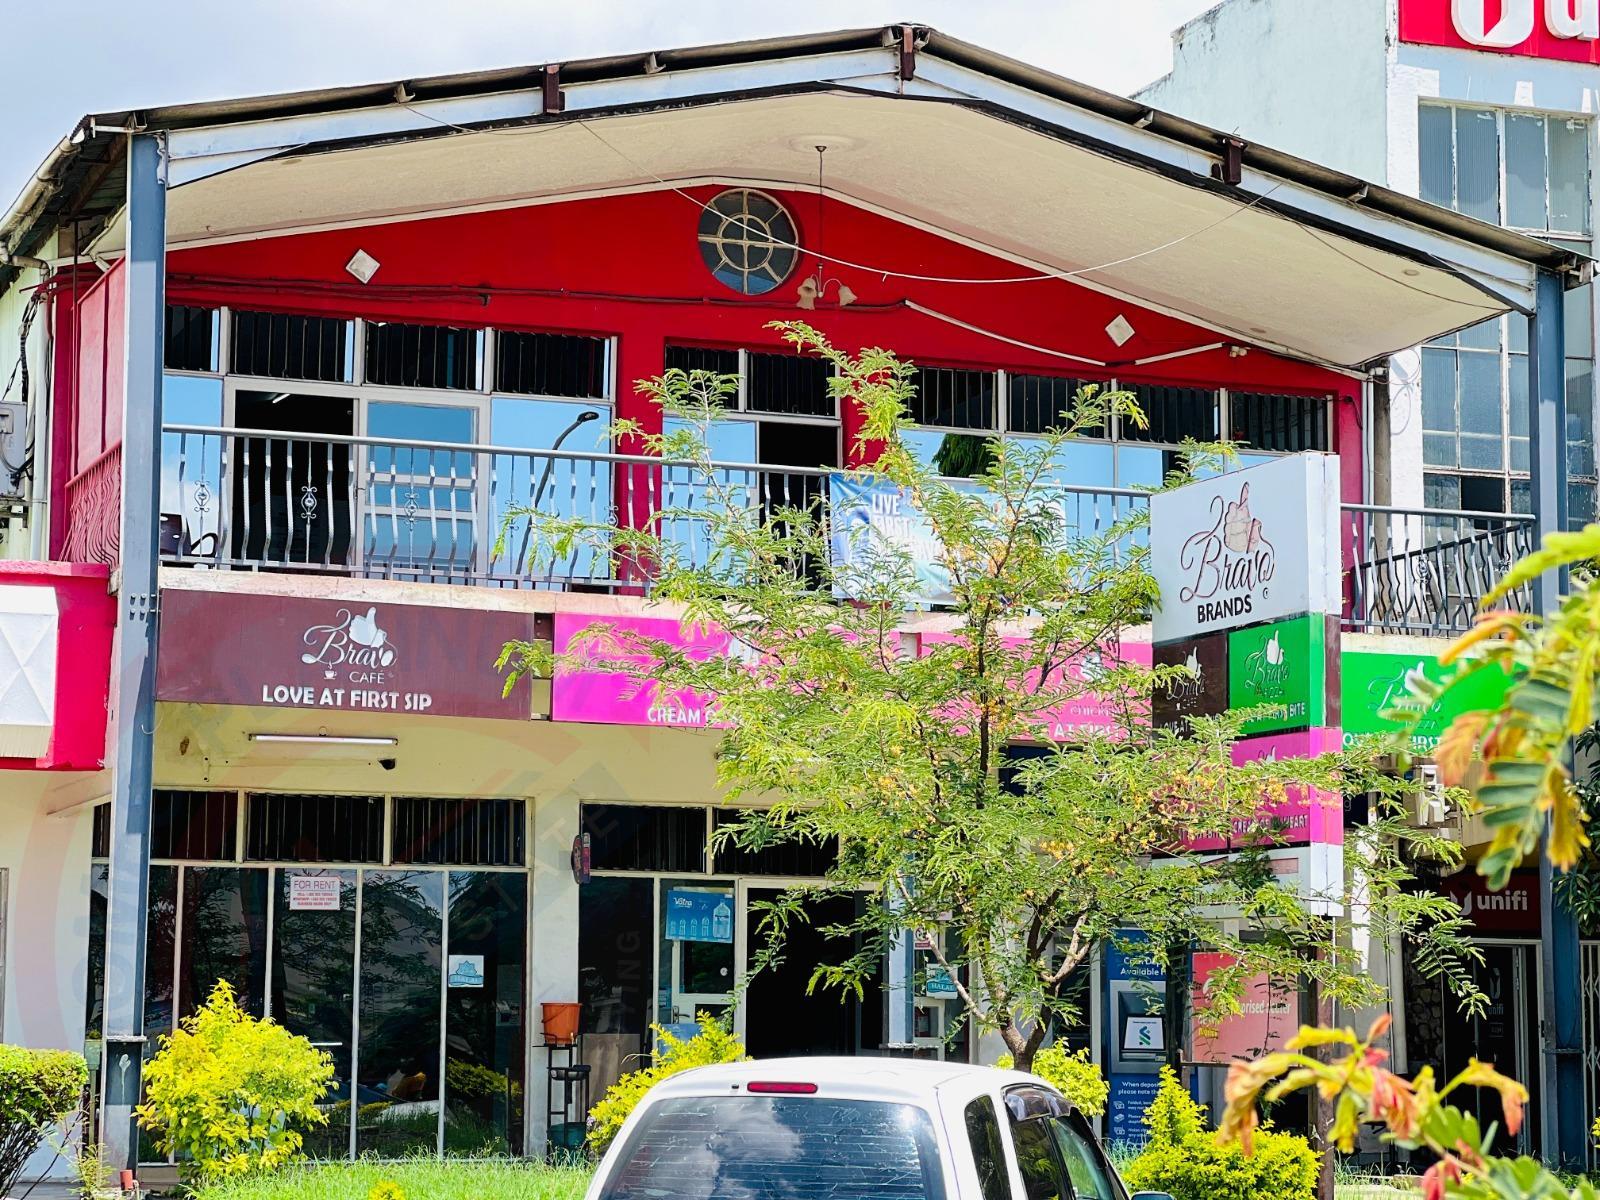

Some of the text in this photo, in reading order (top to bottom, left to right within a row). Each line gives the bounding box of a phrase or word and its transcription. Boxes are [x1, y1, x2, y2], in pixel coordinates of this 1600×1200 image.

[872, 493, 901, 515] LIVE
[1180, 496, 1275, 603] Bravo
[1197, 594, 1253, 624] BRANDS
[301, 609, 399, 670] Bravo
[348, 670, 385, 684] CAFÉ
[262, 684, 433, 711] LOVE AT FIRST SIP
[647, 707, 701, 724] CREAM
[1289, 703, 1306, 717] BITE
[294, 881, 337, 890] FOR RENT
[1477, 890, 1528, 911] unifi
[1120, 967, 1159, 975] Available
